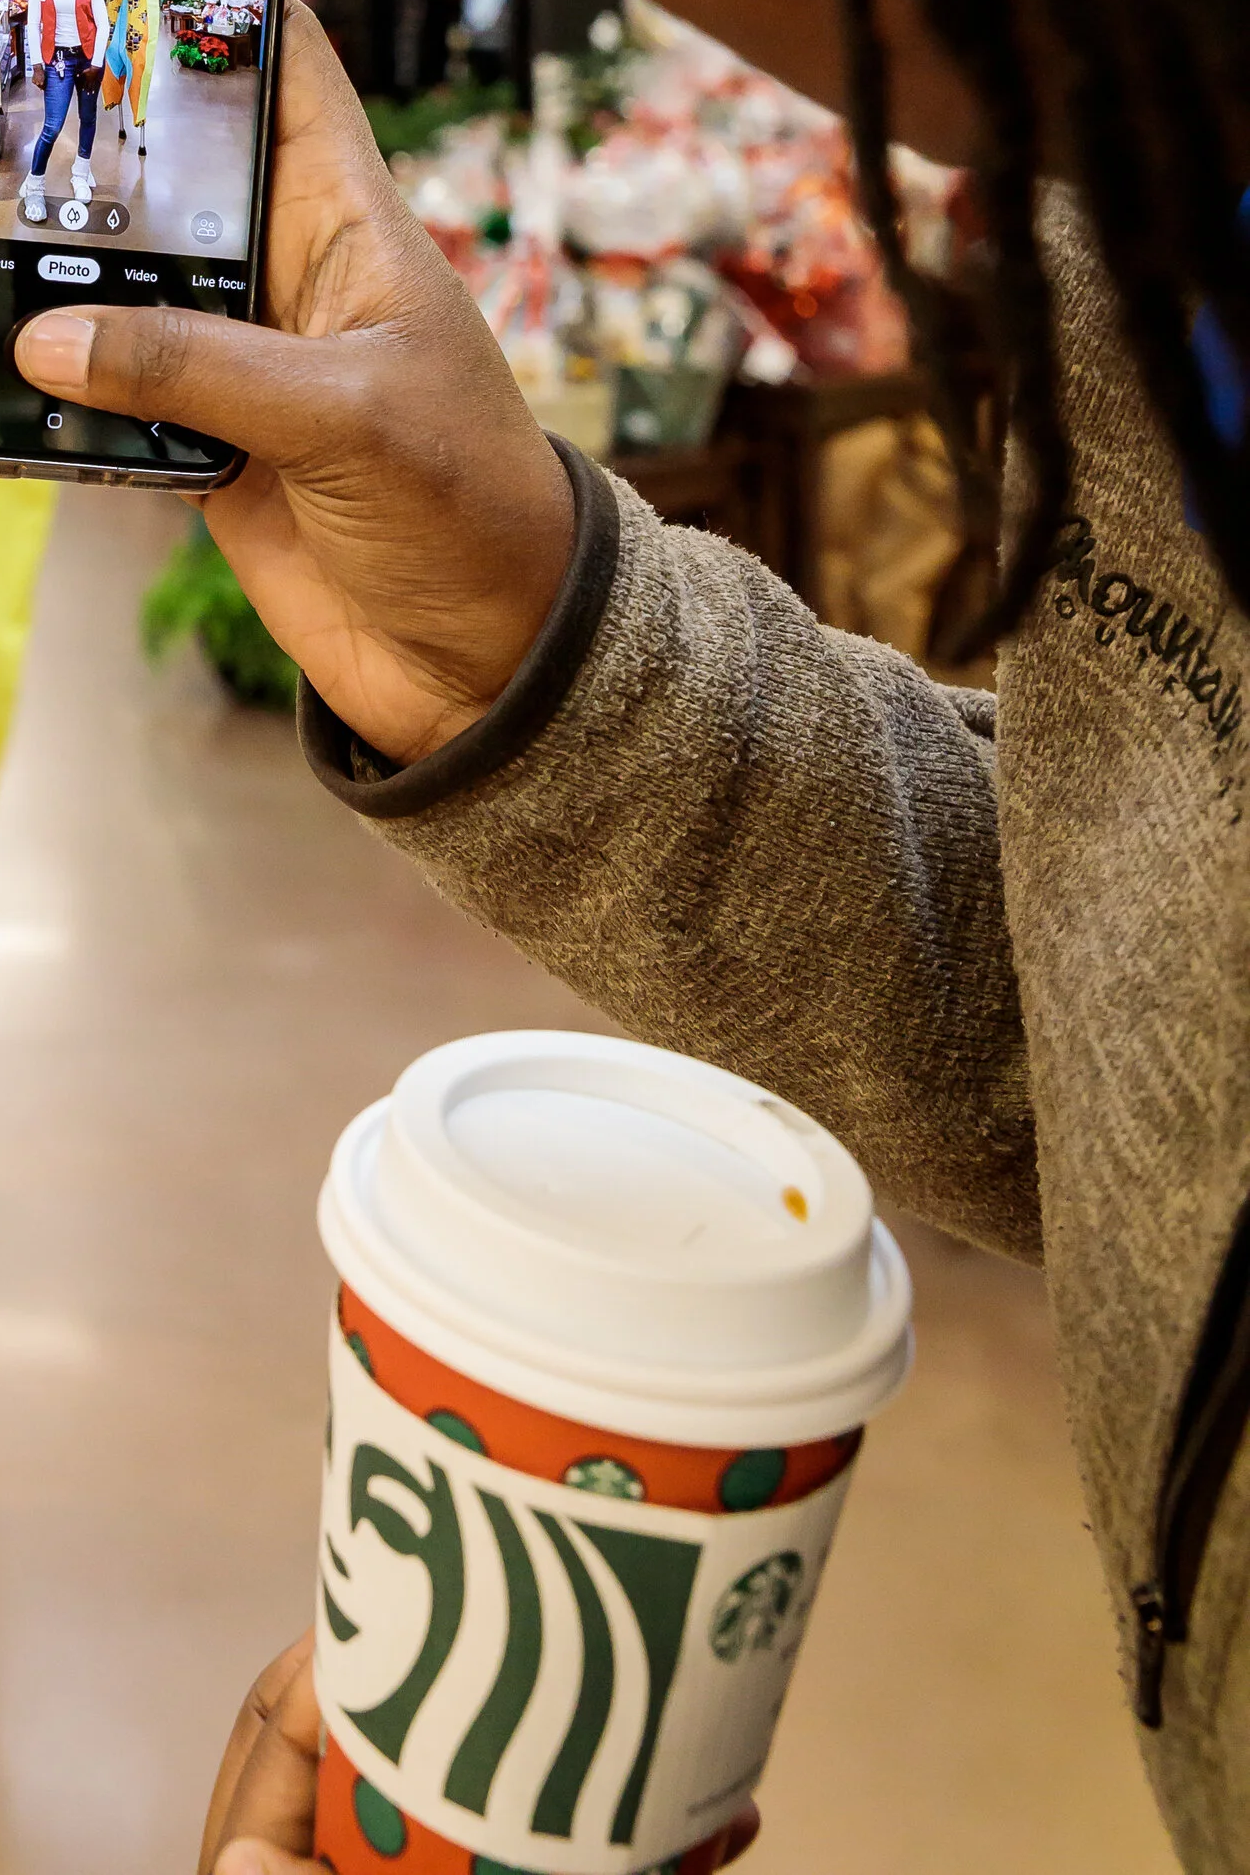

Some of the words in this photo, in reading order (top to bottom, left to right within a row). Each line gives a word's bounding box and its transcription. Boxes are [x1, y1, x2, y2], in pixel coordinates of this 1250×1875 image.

[48, 261, 90, 277] Photo
[124, 268, 158, 282] Video
[191, 275, 215, 288] Live
